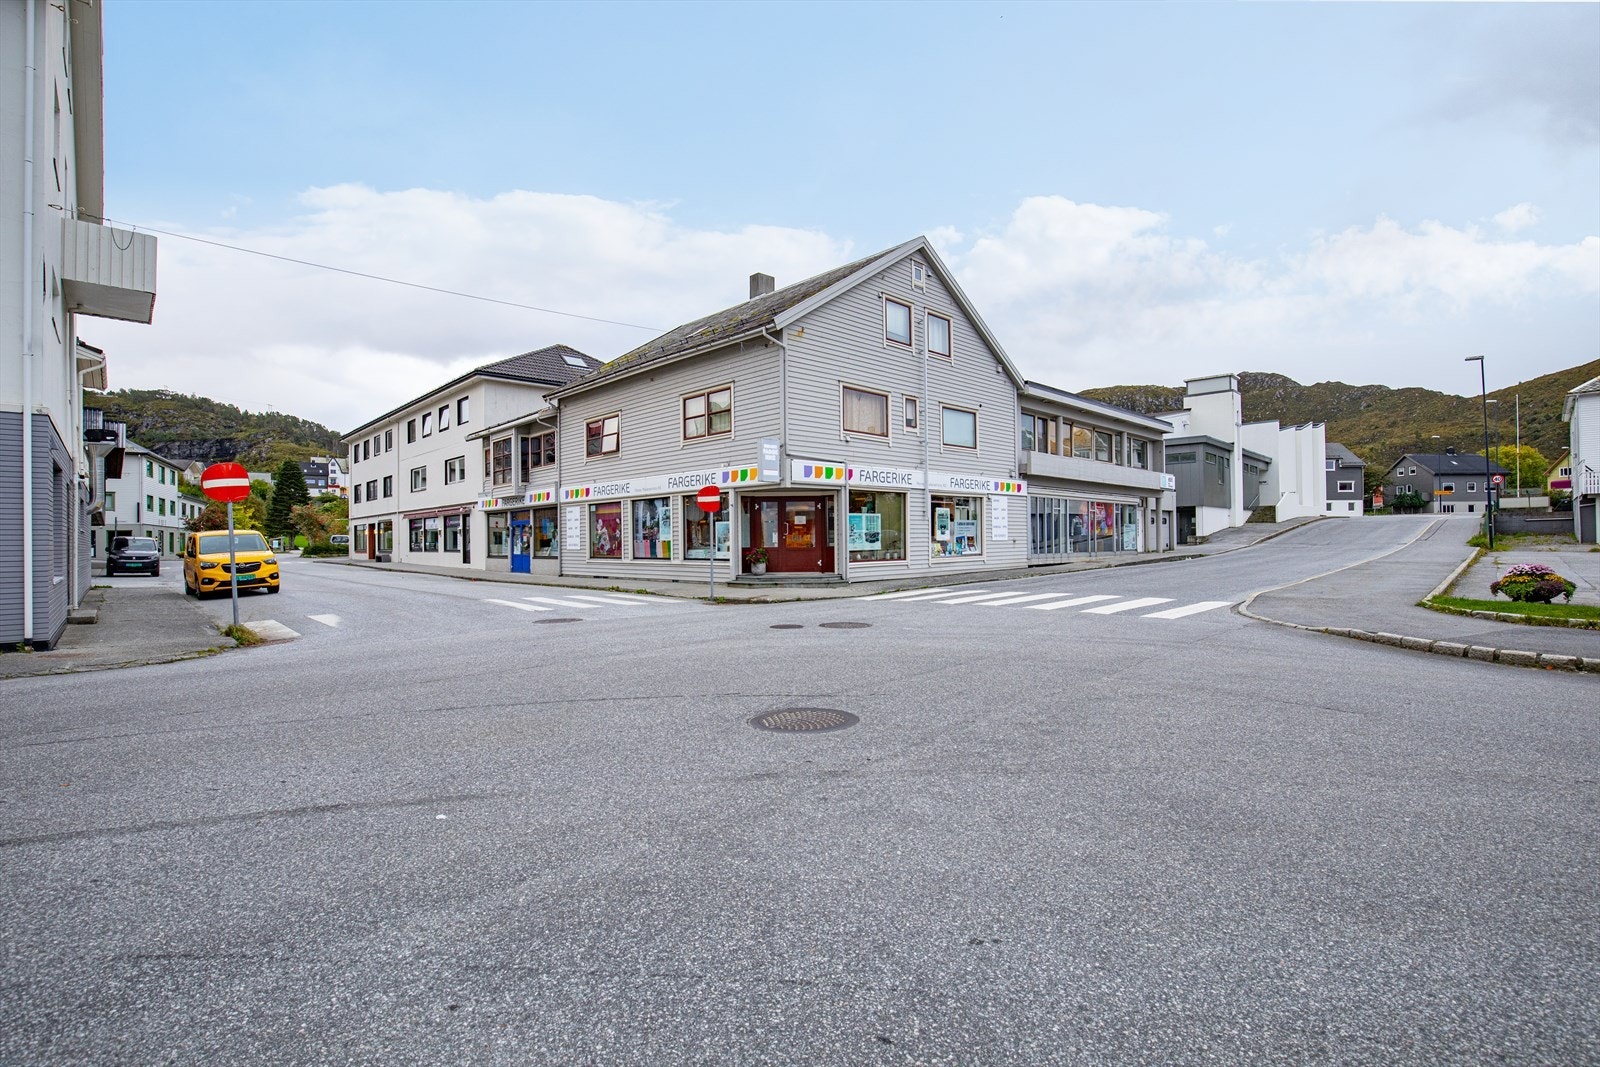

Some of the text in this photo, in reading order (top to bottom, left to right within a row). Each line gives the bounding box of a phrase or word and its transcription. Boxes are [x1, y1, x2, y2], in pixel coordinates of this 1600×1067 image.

[668, 472, 716, 489] FARGERIKE
[859, 470, 912, 485] FARGERIKE
[950, 477, 991, 491] FARGERIKE
[593, 482, 630, 496] FARGERIKE
[502, 496, 525, 507] FARGERIKE
